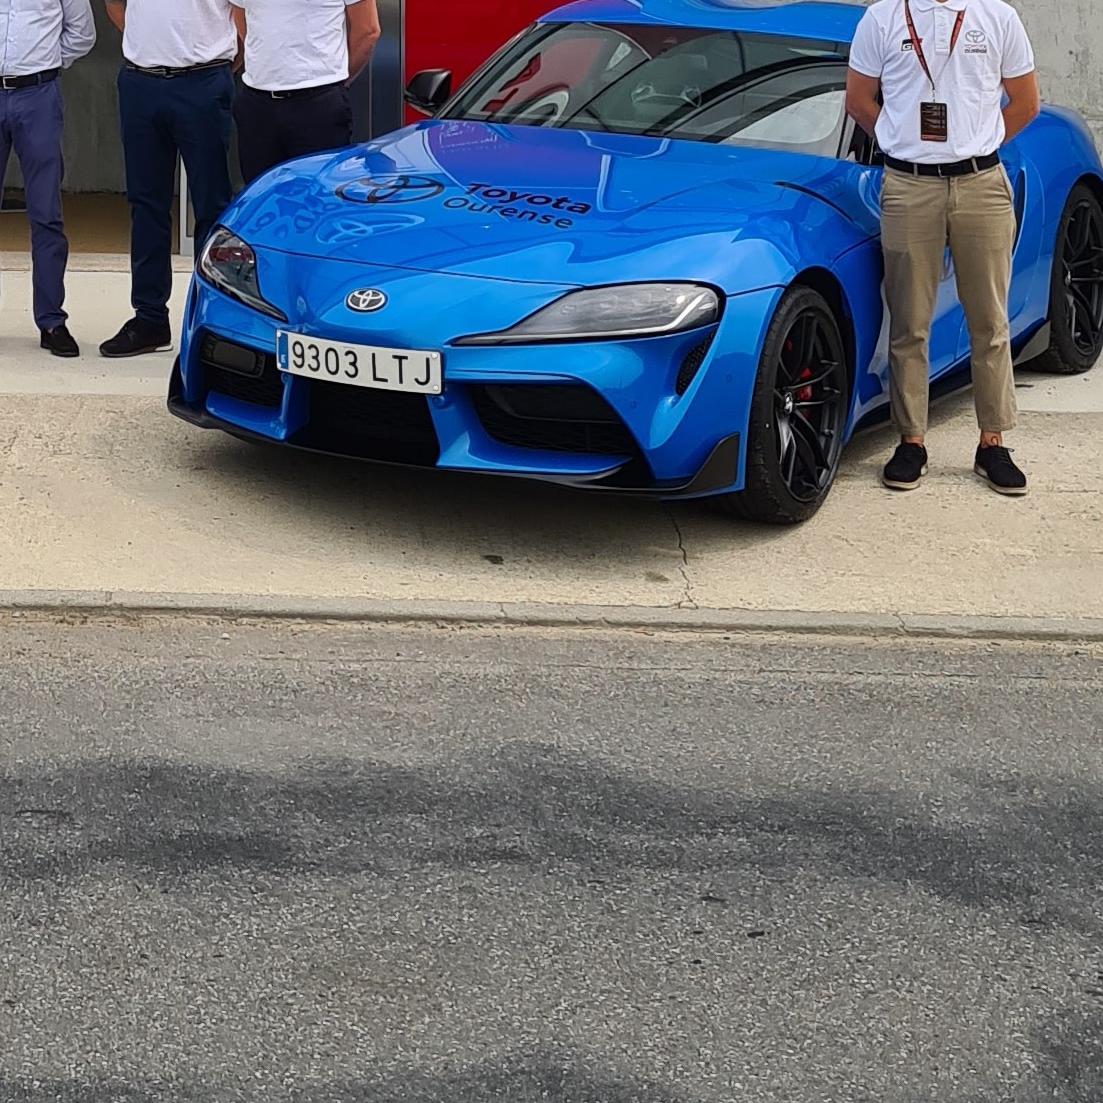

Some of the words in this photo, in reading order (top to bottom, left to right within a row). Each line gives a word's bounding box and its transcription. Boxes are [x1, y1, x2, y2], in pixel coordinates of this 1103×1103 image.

[442, 196, 574, 230] Ourense
[464, 182, 593, 215] Toyota
[291, 340, 360, 379] 9303
[371, 351, 431, 386] LTJ
